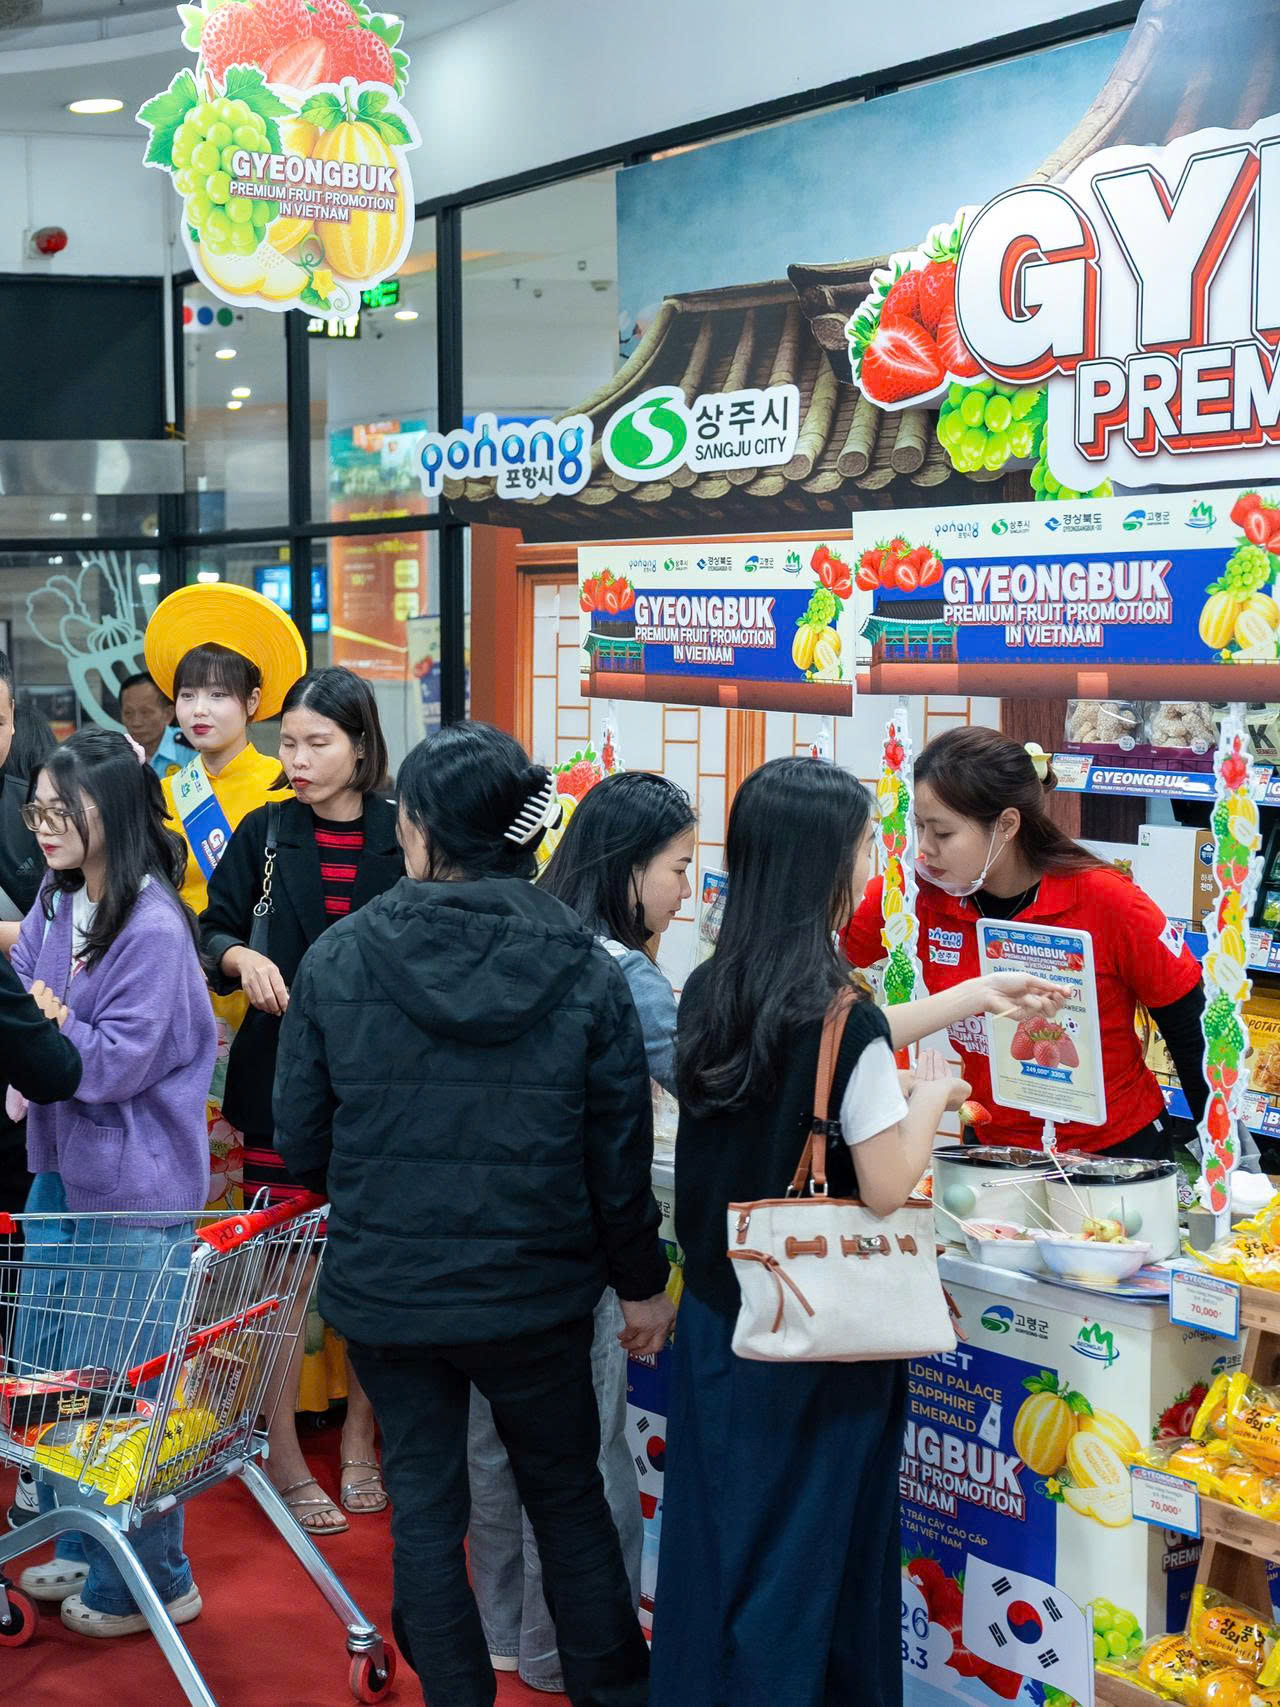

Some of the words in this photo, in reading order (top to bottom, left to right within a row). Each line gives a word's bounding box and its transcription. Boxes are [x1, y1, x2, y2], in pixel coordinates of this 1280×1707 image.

[231, 149, 397, 193] GYEONGBUK
[229, 181, 286, 199] PREMIUM
[288, 188, 323, 203] FRUIT
[325, 192, 394, 211] PROMOTION
[279, 202, 292, 216] IN
[292, 203, 349, 221] VIETNAM
[956, 135, 1280, 382] GY
[695, 396, 789, 440] 상주시
[421, 424, 584, 488] pohang
[696, 441, 751, 461] SANGJU
[754, 436, 787, 455] CITY
[505, 464, 554, 489] 포항시
[1063, 513, 1102, 525] 경상북도
[1147, 511, 1170, 522] 고령군
[943, 560, 1172, 604] GYEONGBUK
[634, 595, 776, 628] GYEONGBUK
[944, 605, 1015, 623] PREMIUM
[1017, 603, 1065, 622] FRUIT
[1067, 601, 1170, 622] PROMOTION
[635, 626, 679, 642] PREMIUM
[682, 628, 710, 643] FRUIT
[711, 629, 774, 645] PROMOTION
[1005, 626, 1021, 643] IN
[1024, 624, 1101, 643] VIETNAM
[673, 645, 685, 659] IN
[686, 646, 732, 662] VIETNAM
[1247, 724, 1276, 749] K
[937, 951, 958, 960] 상주시
[1002, 941, 1067, 960] GYEONGBUK
[1049, 974, 1084, 985] GORYEONG
[1248, 1019, 1280, 1033] POTAT
[1015, 1313, 1049, 1334] 고령군
[908, 1361, 943, 1384] LDEN
[947, 1374, 1002, 1403] PALACE
[908, 1380, 976, 1414] SAPPHIRE
[911, 1400, 977, 1433] EMERALD
[904, 1420, 1022, 1496] NGBUK
[899, 1476, 954, 1514] ETNAM
[921, 1465, 1022, 1516] PROMOTION
[941, 1535, 962, 1550] NAM
[947, 1524, 967, 1539] CAO
[1163, 1550, 1200, 1571] PREMI
